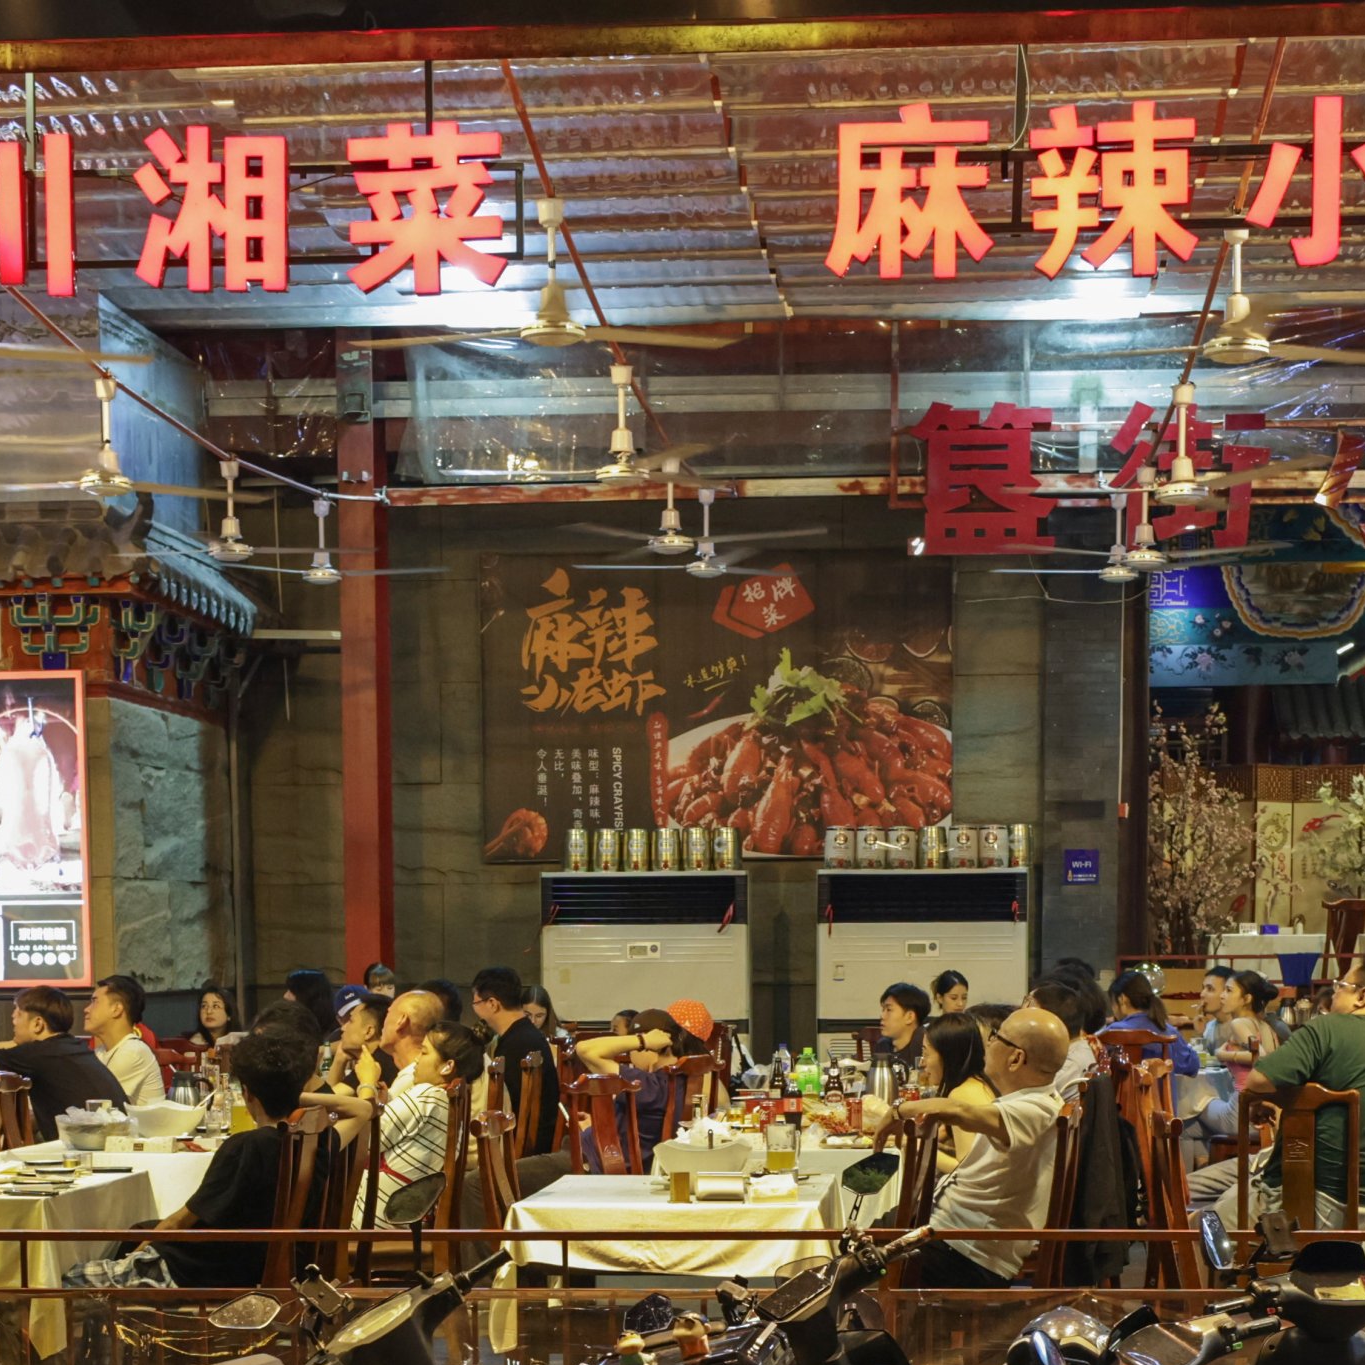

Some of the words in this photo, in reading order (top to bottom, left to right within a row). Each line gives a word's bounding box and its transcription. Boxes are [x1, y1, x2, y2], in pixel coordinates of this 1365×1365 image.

[742, 577, 797, 602] 招牌
[522, 567, 660, 682] 麻辣
[761, 602, 787, 629] 菜
[520, 666, 667, 718] 小龙虾
[611, 746, 623, 778] SPICY
